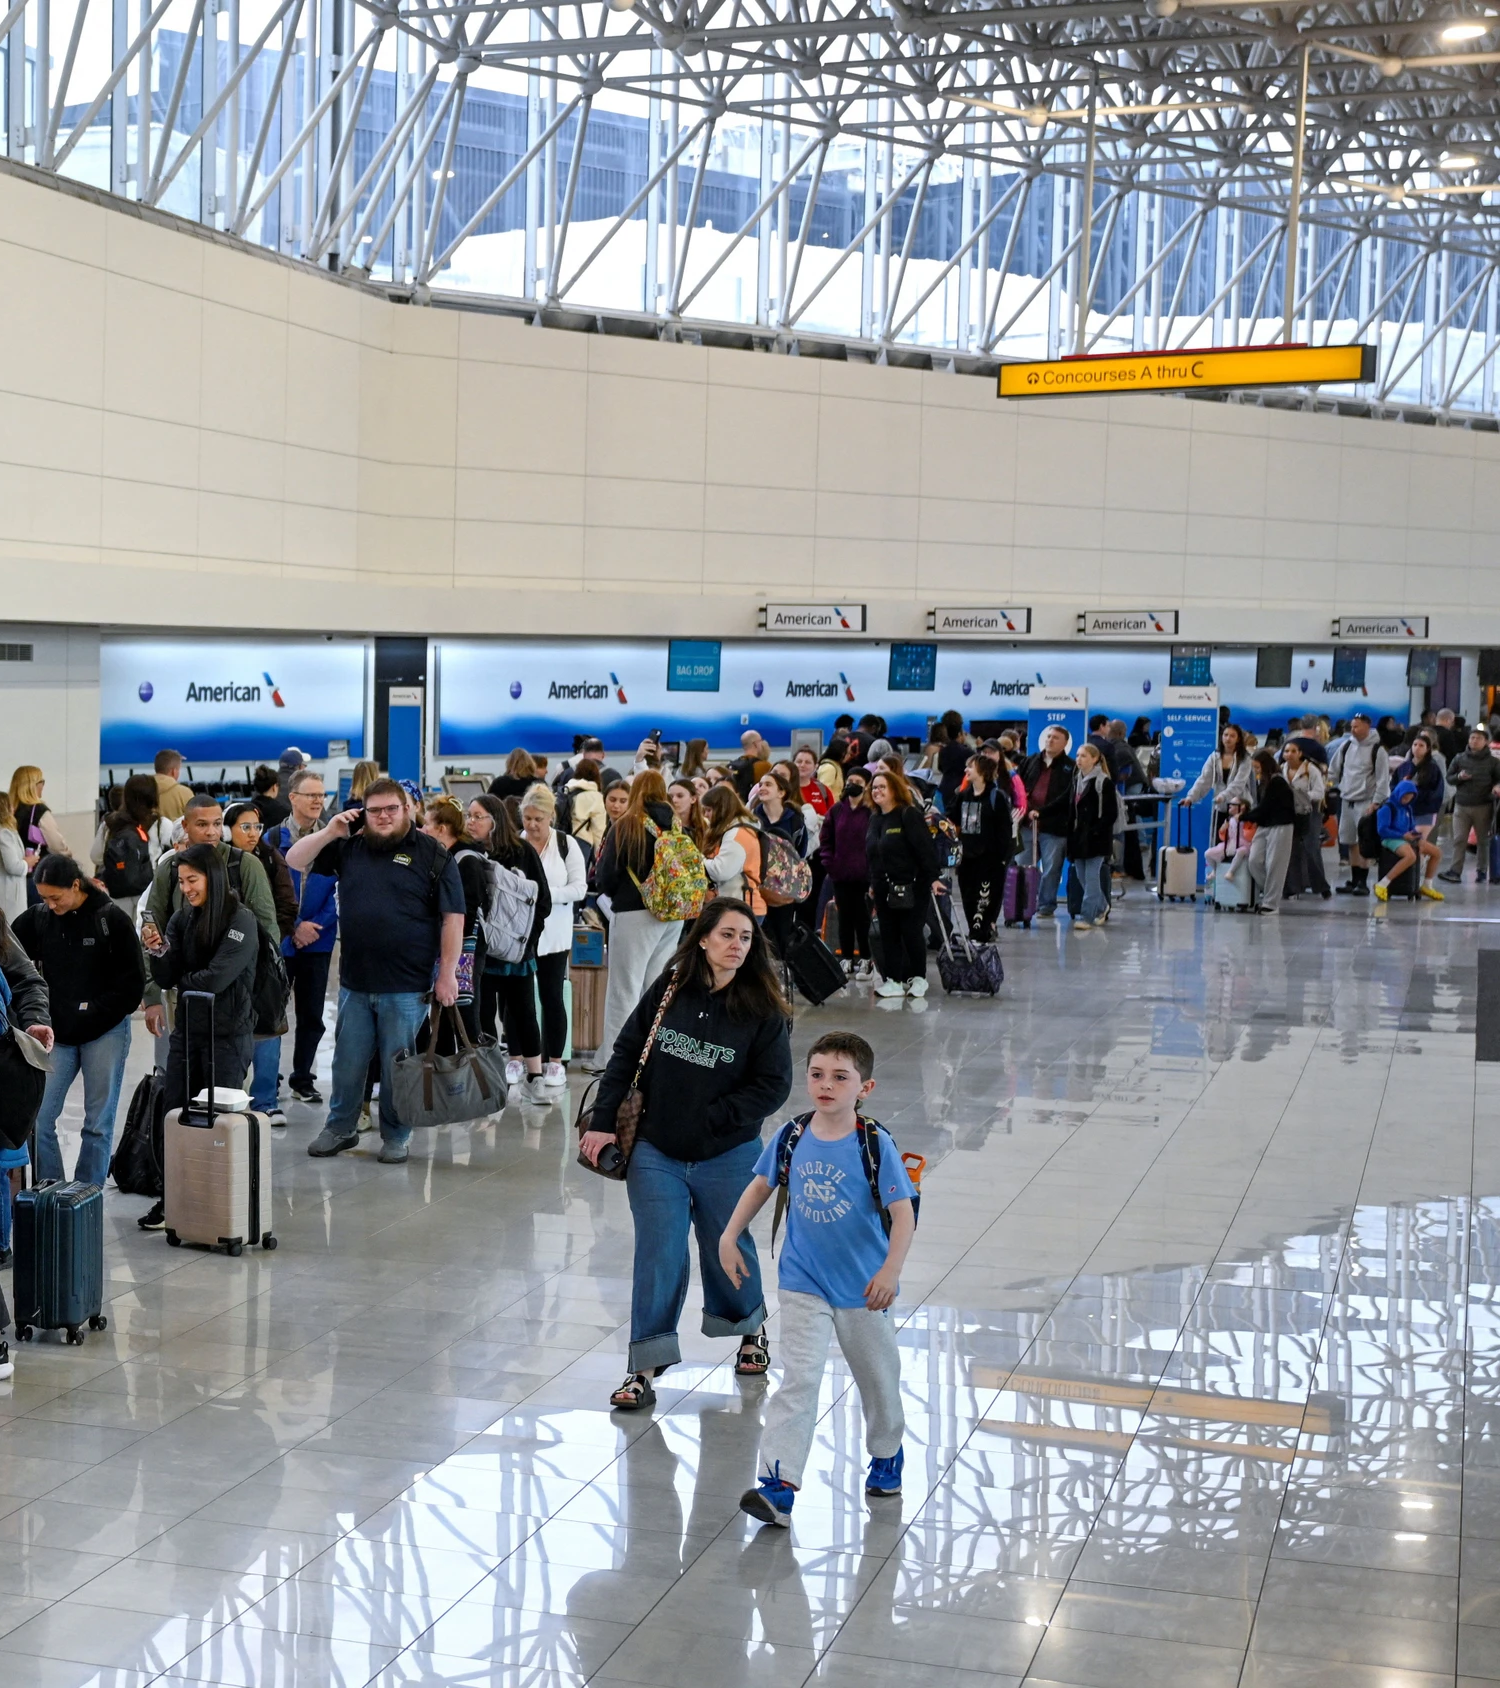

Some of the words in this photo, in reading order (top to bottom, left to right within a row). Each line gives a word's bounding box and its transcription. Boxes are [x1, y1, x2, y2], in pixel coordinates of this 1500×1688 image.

[1043, 369, 1136, 385] Concourses
[1140, 365, 1152, 380] A
[1157, 365, 1187, 379] thru
[1191, 361, 1204, 378] C
[774, 612, 832, 626] American
[942, 616, 998, 628] American
[1092, 618, 1147, 630] American
[1346, 623, 1399, 634] American
[676, 665, 692, 676] BAG
[693, 665, 714, 676] DROP
[186, 681, 260, 702] American
[548, 680, 608, 699] American
[785, 679, 838, 697] American
[990, 679, 1035, 696] America
[1047, 713, 1066, 722] STEP
[1167, 714, 1212, 722] SELF-SERVICE
[655, 1026, 736, 1063] HORNETS
[660, 1042, 717, 1069] LACROSSE
[797, 1161, 846, 1185] NORTH
[795, 1194, 854, 1223] CAROLINA
